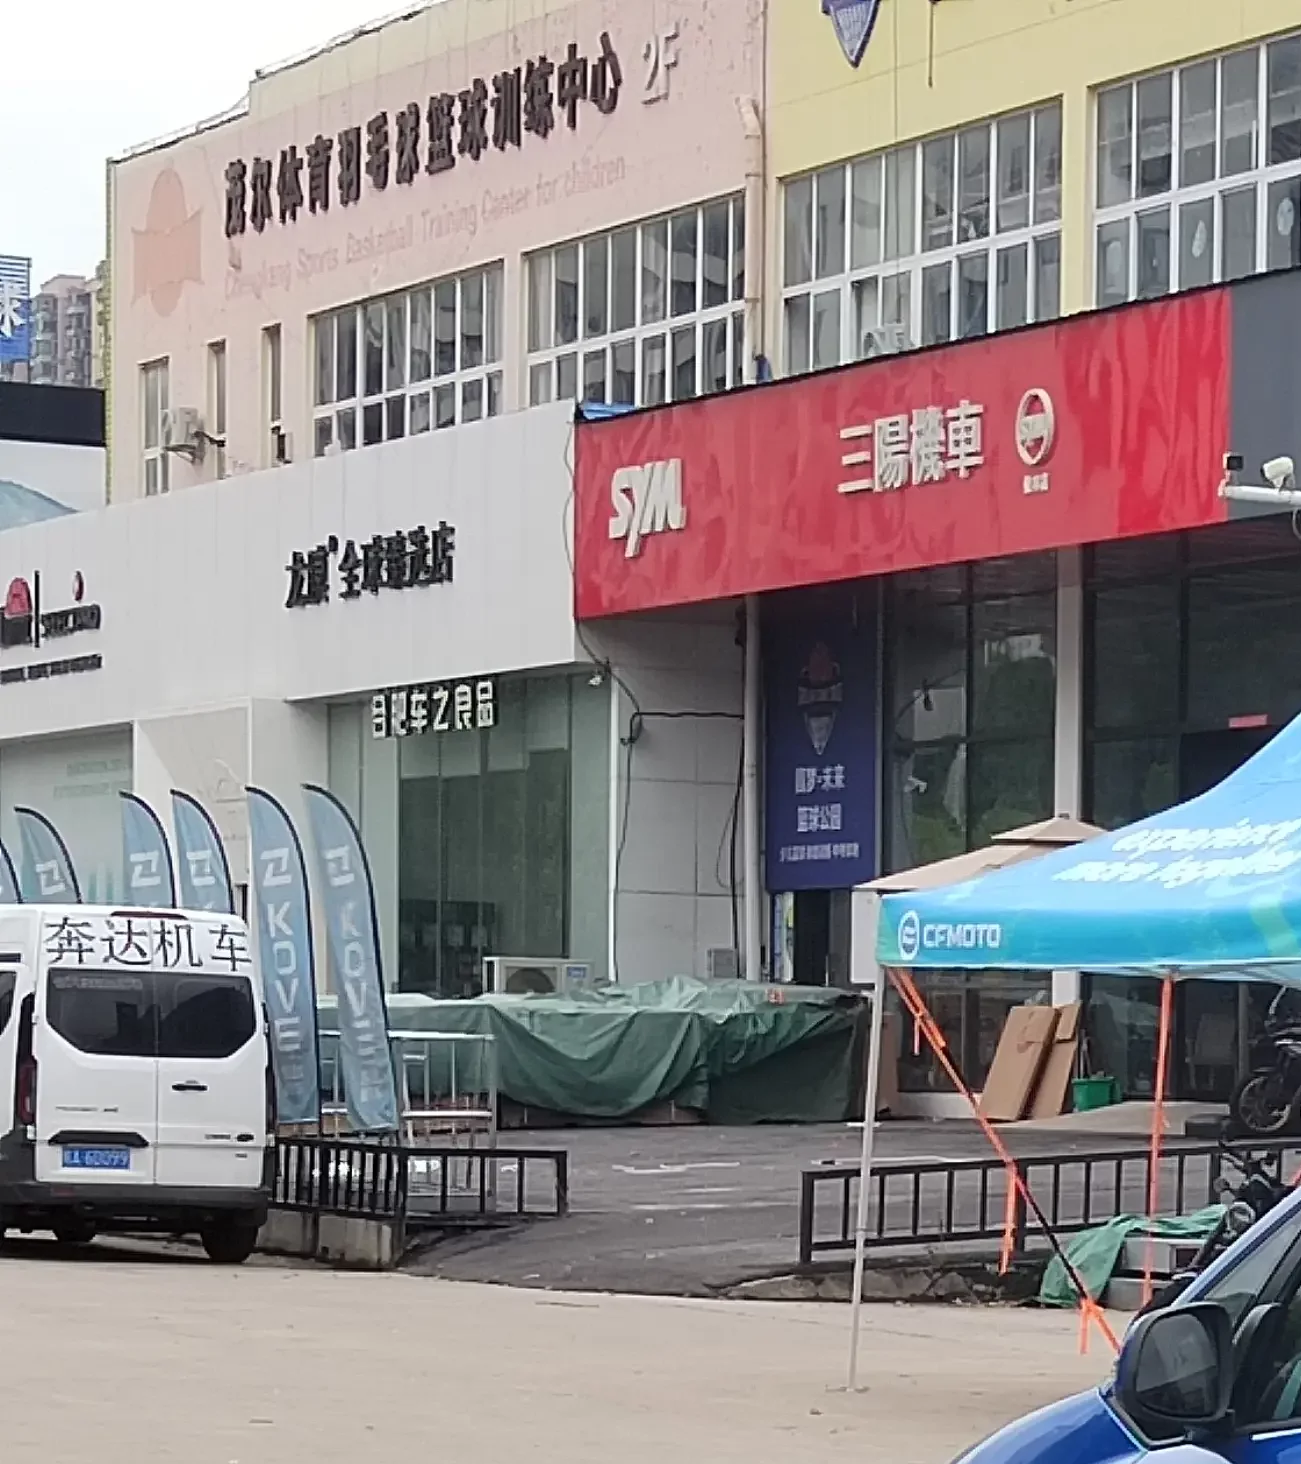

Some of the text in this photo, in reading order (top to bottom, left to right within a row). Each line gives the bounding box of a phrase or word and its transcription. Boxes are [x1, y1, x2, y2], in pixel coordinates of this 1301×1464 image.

[643, 22, 681, 104] 2F
[838, 400, 984, 493] 三陽機車
[609, 459, 686, 557] SYM
[45, 917, 252, 971] 奔达机车
[924, 924, 1000, 949] CFMOTO
